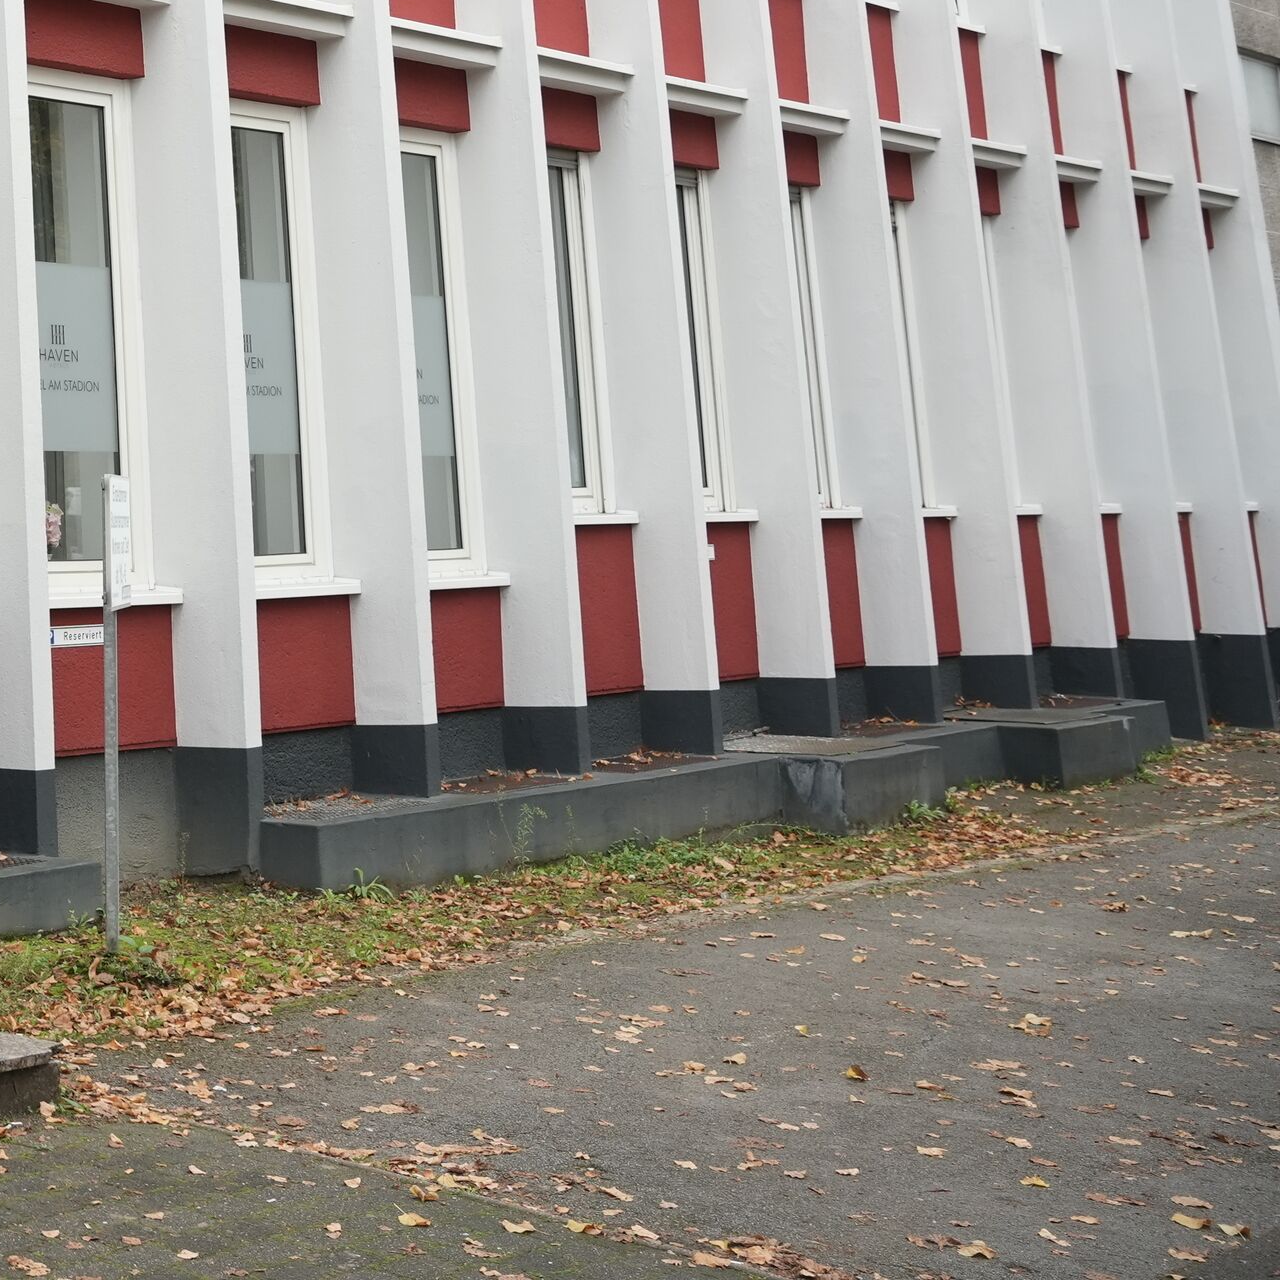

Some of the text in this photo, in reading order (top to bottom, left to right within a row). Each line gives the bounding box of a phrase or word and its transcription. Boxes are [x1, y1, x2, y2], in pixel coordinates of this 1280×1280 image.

[39, 348, 79, 363] HAVEN
[48, 379, 62, 391] AM
[63, 379, 100, 392] STADION
[252, 386, 282, 396] STADION
[63, 630, 102, 641] Reserviert
